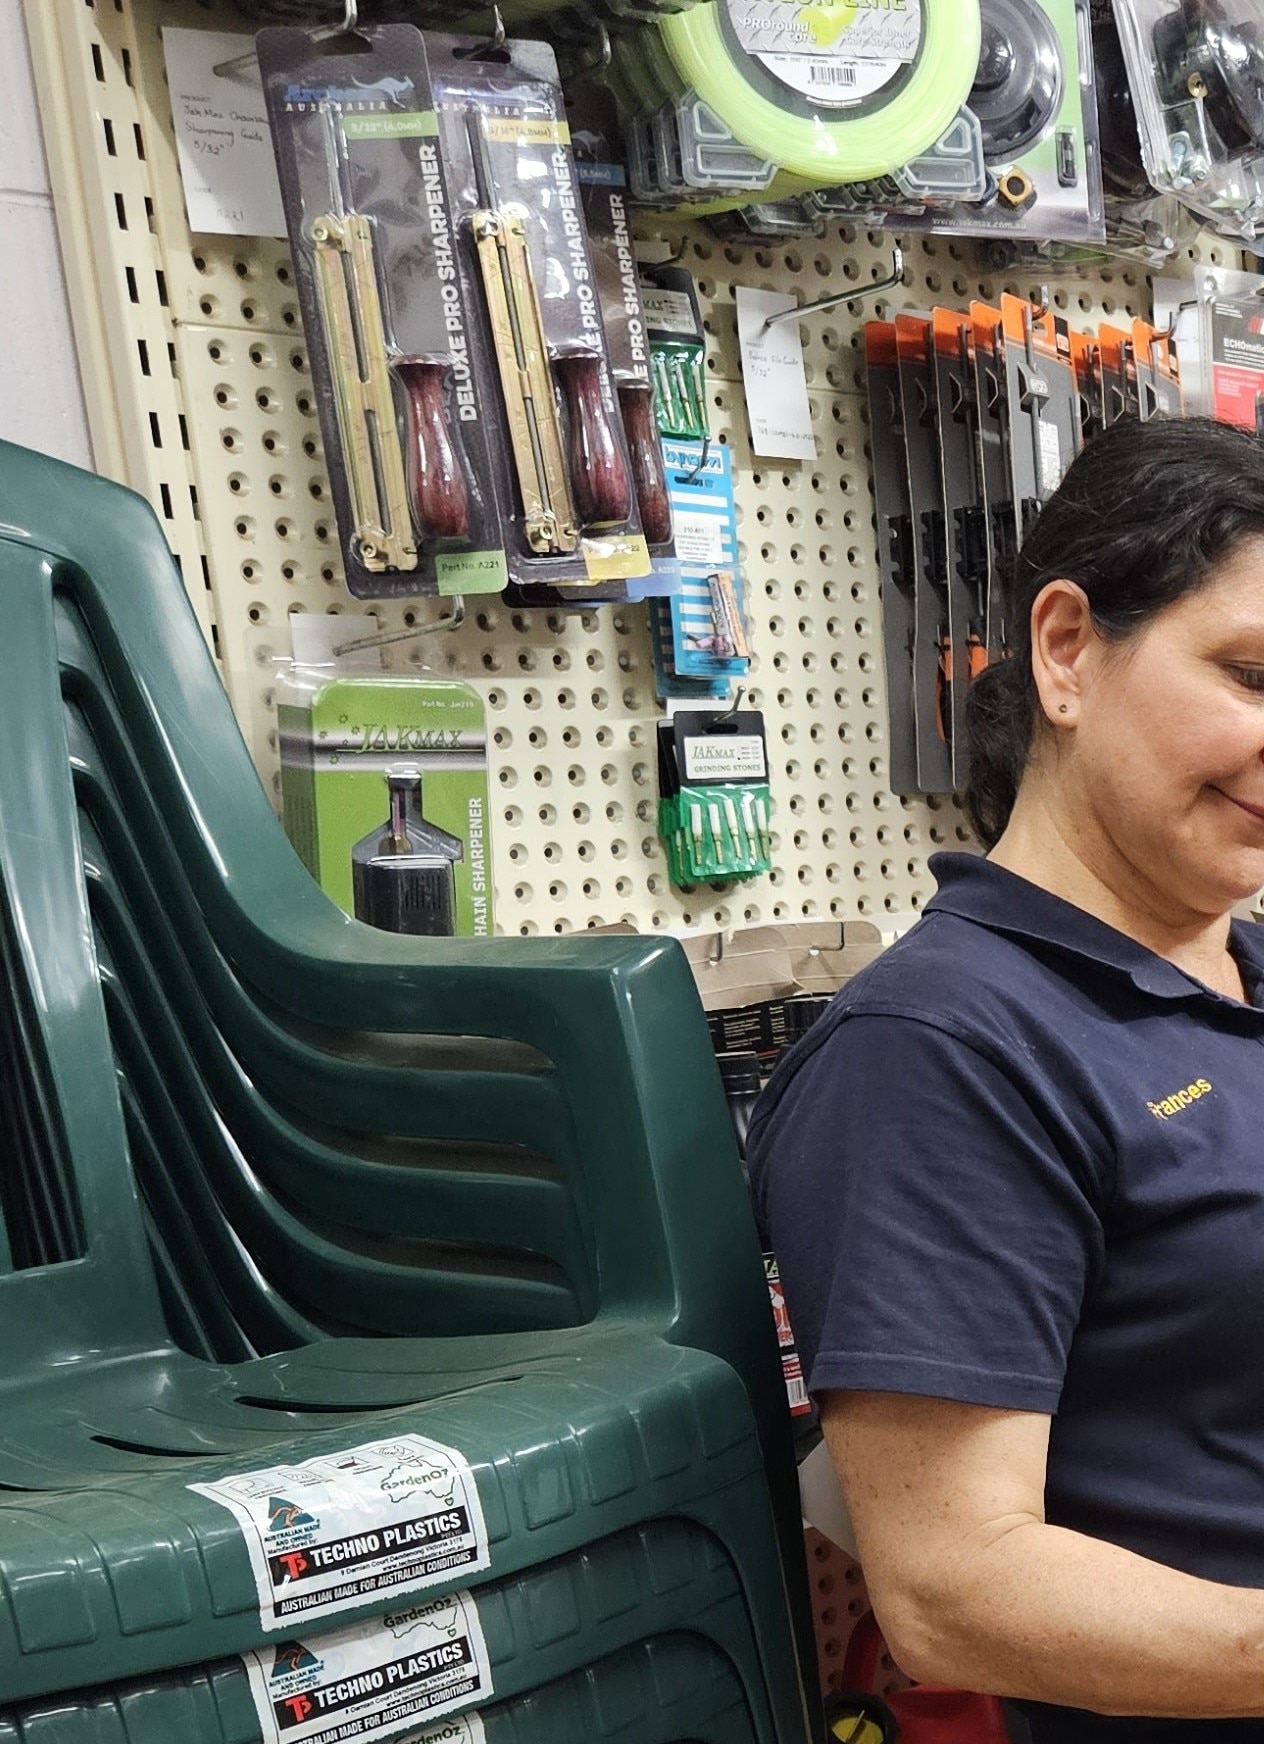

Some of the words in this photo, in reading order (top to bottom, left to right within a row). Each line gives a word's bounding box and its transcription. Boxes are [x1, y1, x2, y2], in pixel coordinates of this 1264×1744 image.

[419, 144, 456, 283] SHARPENER
[551, 148, 590, 281] SHARPENER
[609, 193, 640, 316] SHARPENER
[440, 284, 464, 334] PRO
[576, 283, 600, 329] PRO
[627, 318, 647, 368] PRO
[447, 335, 477, 422] DELUXE
[441, 561, 460, 572] Part
[477, 559, 500, 570] A221
[355, 723, 464, 755] JAKMAX
[691, 745, 736, 760] JAKMAX
[694, 764, 732, 773] GRINDING
[732, 764, 761, 772] STONES
[468, 797, 486, 893] SHARPENER
[474, 895, 488, 938] HAIN
[310, 1534, 380, 1567] TECHNO
[383, 1512, 461, 1547] PLASTICS
[280, 1589, 333, 1614] AUSTRALIAN
[333, 1583, 359, 1598] MADE
[360, 1579, 376, 1592] FOR
[378, 1565, 426, 1587] AUSTRALIAN
[426, 1550, 471, 1573] CONDITIONS
[383, 1597, 452, 1629] GardenOz
[313, 1675, 384, 1708] TECHNO
[386, 1642, 463, 1685] PLASTICS
[338, 1720, 364, 1740] MADE
[364, 1714, 380, 1729] FOR
[382, 1697, 431, 1722] AUSTRALIAN
[430, 1679, 474, 1705] CONDITIONS
